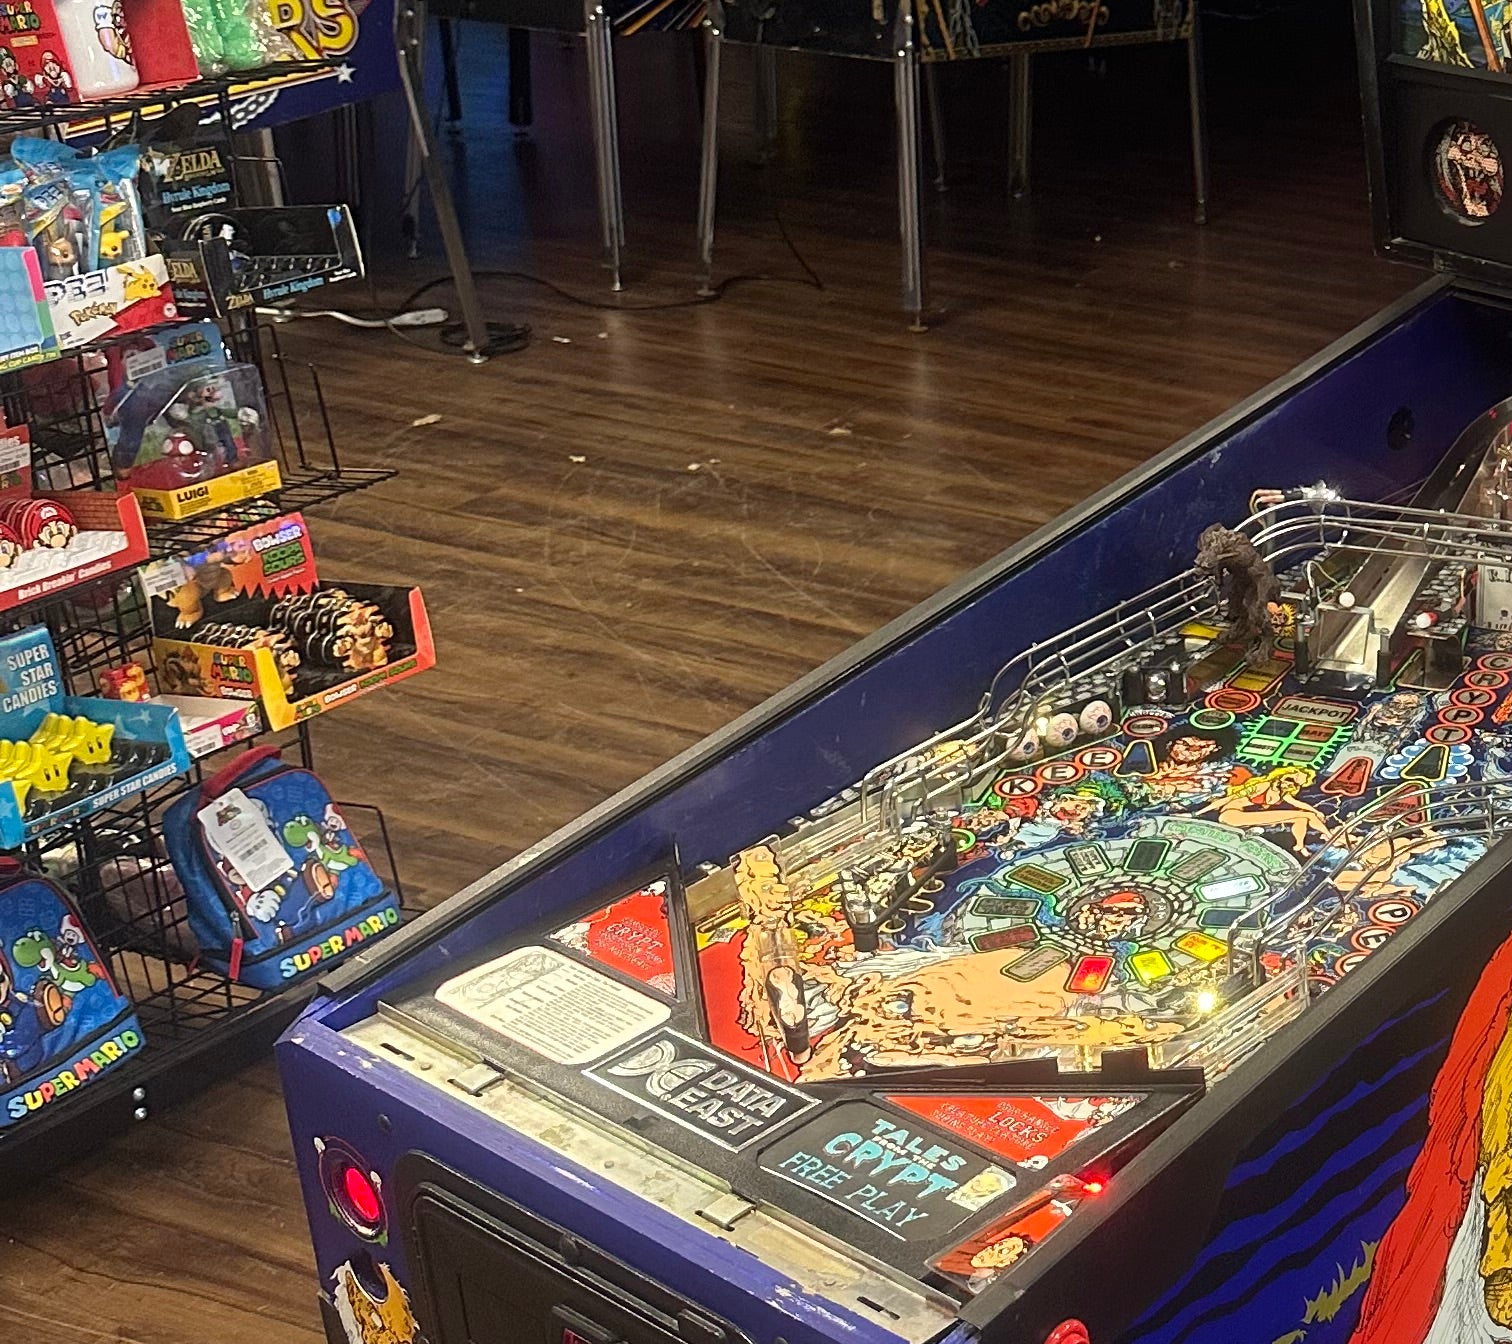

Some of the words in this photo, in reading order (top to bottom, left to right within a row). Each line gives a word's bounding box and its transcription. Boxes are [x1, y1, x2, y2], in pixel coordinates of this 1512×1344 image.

[164, 147, 224, 183] ZELDA
[176, 485, 209, 503] LUIGI
[252, 524, 303, 553] BOWSER
[18, 581, 42, 600] Brick
[78, 560, 112, 580] Candies
[7, 644, 50, 671] SUPER
[20, 662, 55, 686] STAR
[211, 663, 253, 683] MARIO
[2, 680, 58, 714] CANDIES
[1281, 703, 1350, 720] JACKPOT
[92, 788, 120, 809] SUPER
[120, 779, 142, 799] STAR
[142, 762, 178, 786] CANDIES
[280, 928, 346, 980] SUPER
[343, 906, 399, 945] MARIO
[606, 922, 664, 949] CRYPT
[7, 1069, 82, 1119] SUPER
[78, 1029, 141, 1081] MARIO
[668, 1086, 765, 1136] EAST
[699, 1069, 787, 1119] DATA
[871, 1118, 968, 1172] TALES
[987, 1111, 1050, 1144] LOCKS
[823, 1132, 960, 1201] CRYPT
[779, 1151, 853, 1192] FREE
[846, 1182, 929, 1228] PLAY
